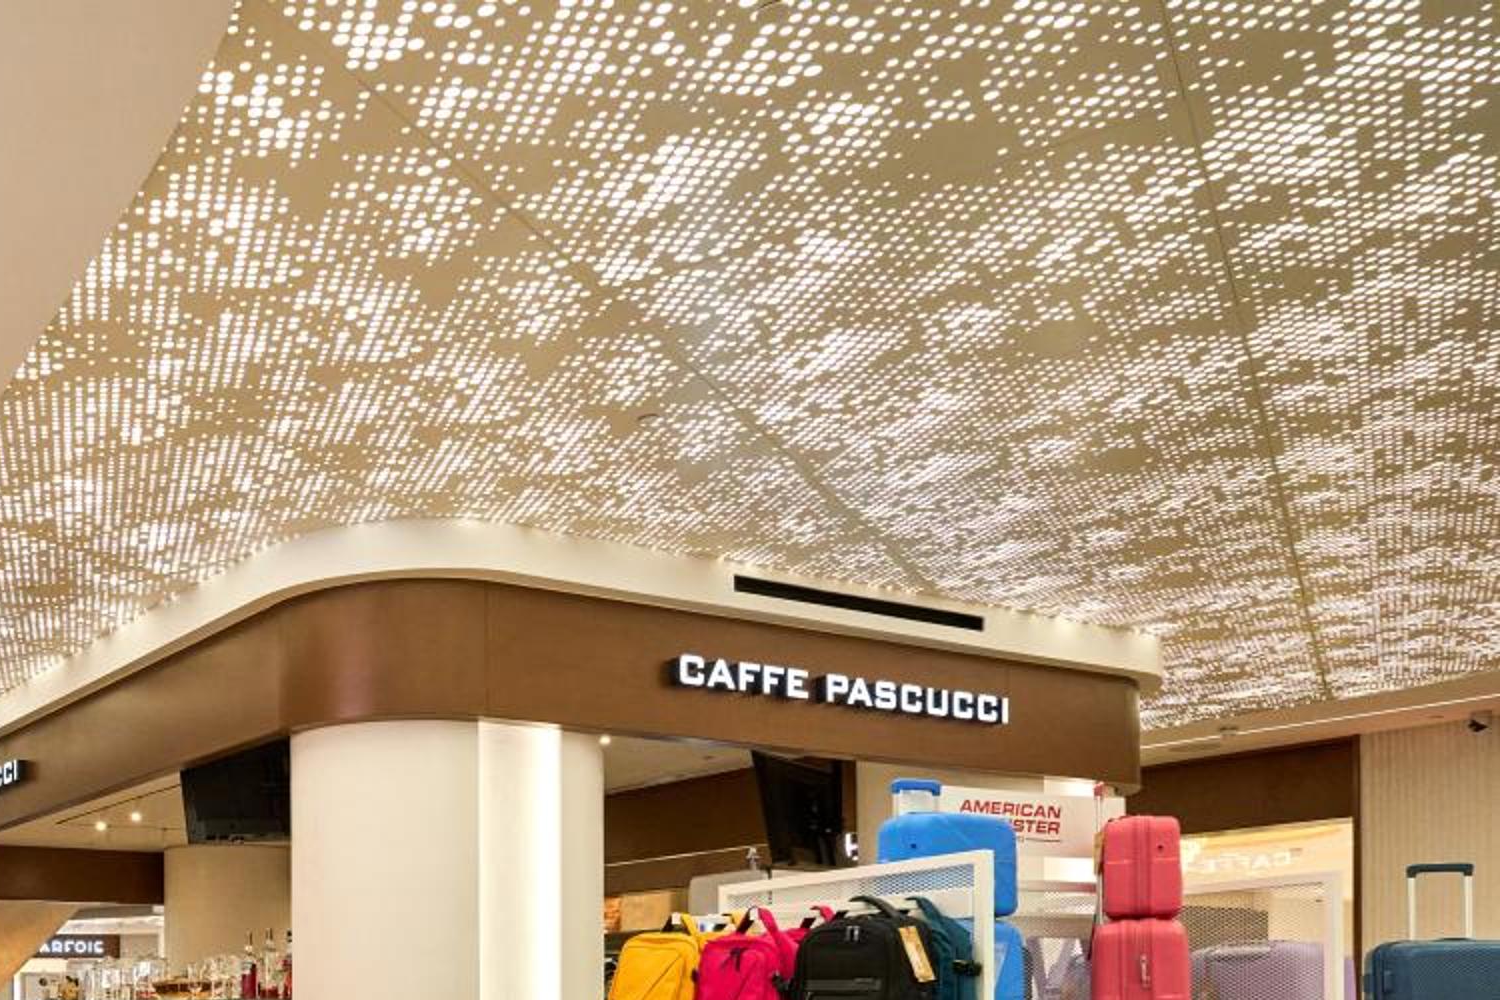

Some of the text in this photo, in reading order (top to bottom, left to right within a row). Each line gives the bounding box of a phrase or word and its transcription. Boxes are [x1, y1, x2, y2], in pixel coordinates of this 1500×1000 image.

[678, 653, 1010, 725] CAFFE PASCUCCI
[959, 799, 1061, 819] AMERICAN
